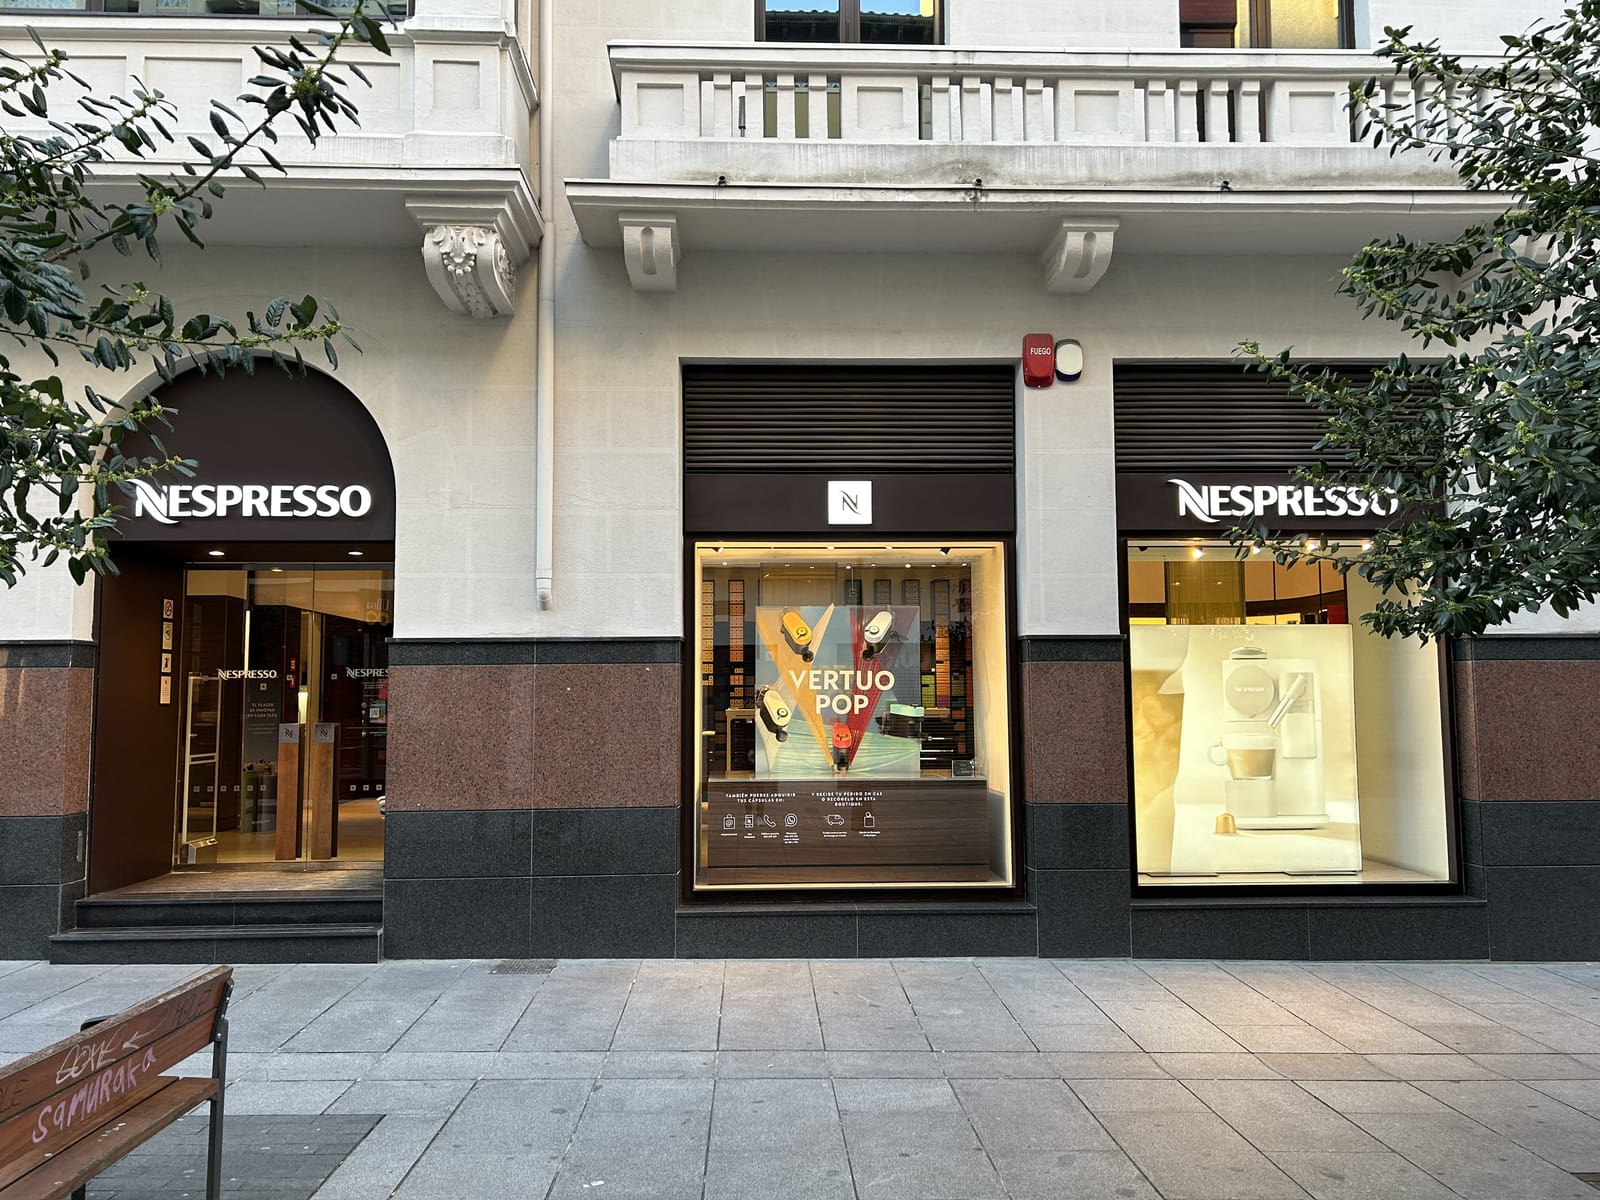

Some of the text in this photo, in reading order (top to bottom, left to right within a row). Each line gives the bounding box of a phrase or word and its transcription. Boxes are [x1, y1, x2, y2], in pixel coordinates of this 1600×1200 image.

[1030, 347, 1052, 355] FUEGO
[125, 478, 372, 524] NESPRESSO
[839, 489, 862, 515] N
[1167, 478, 1399, 523] NESPRESSO
[216, 668, 278, 680] NESPRESSO
[789, 670, 895, 691] VERTUO
[815, 694, 869, 715] POP
